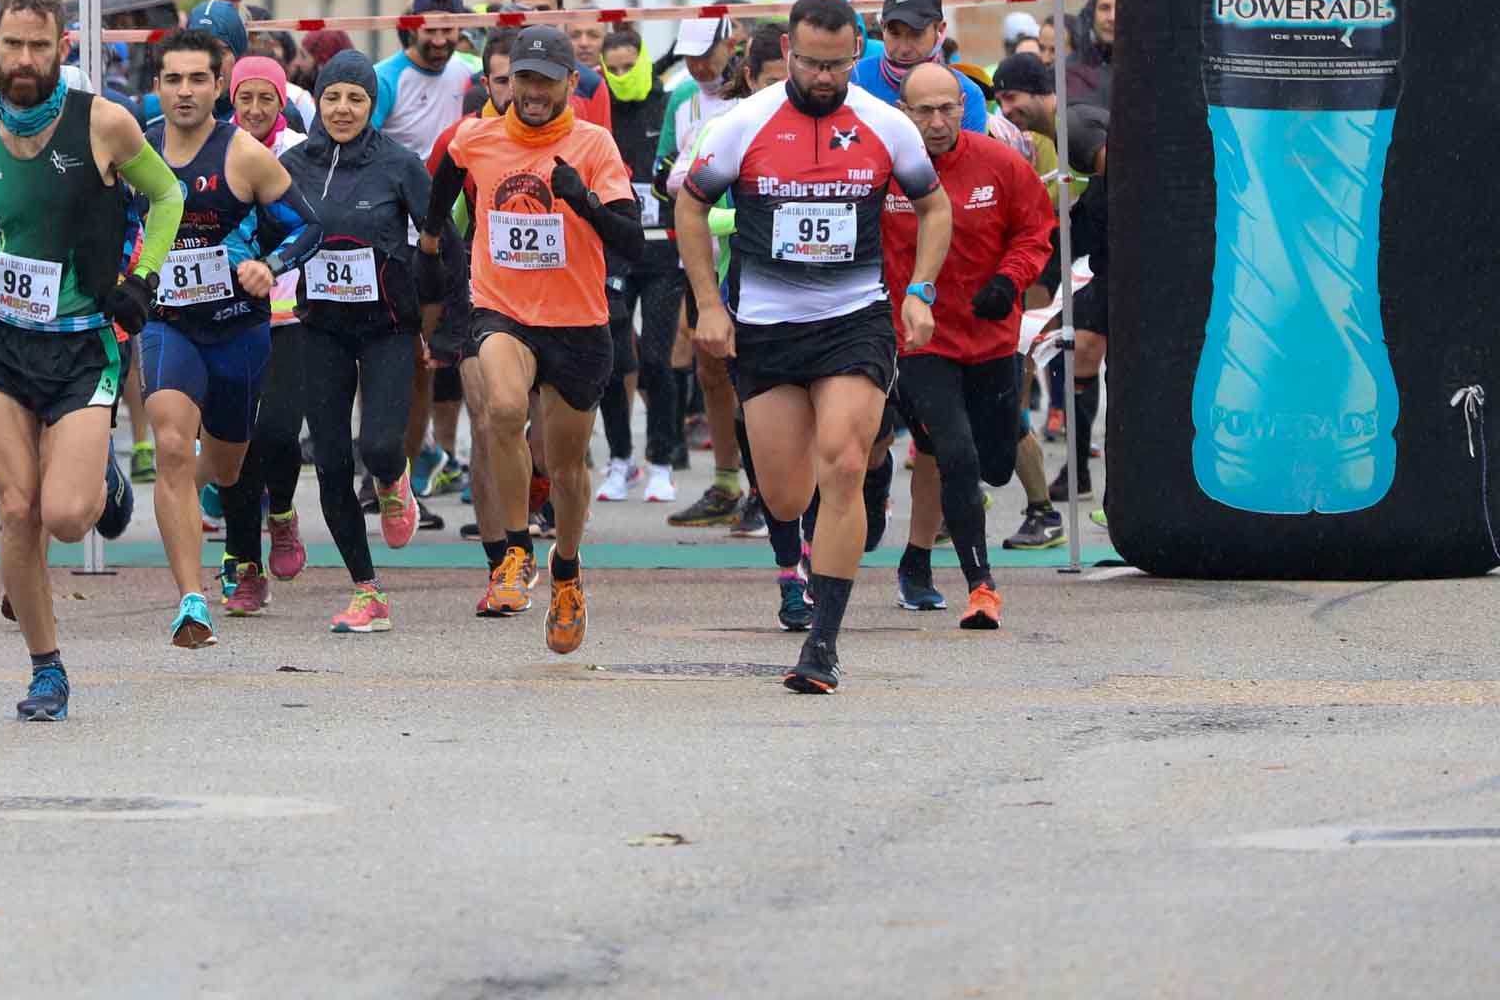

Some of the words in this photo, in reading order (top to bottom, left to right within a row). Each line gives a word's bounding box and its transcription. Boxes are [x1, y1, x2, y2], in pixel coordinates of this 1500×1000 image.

[509, 227, 540, 251] 82
[798, 217, 831, 243] 95
[494, 249, 560, 264] JOMISAGA
[777, 242, 849, 255] JOMISAGA
[3, 269, 32, 299] 98
[172, 262, 203, 288] 81
[326, 262, 353, 285] 84
[163, 281, 226, 301] JOMISAGA
[311, 283, 373, 296] JOMISAGA
